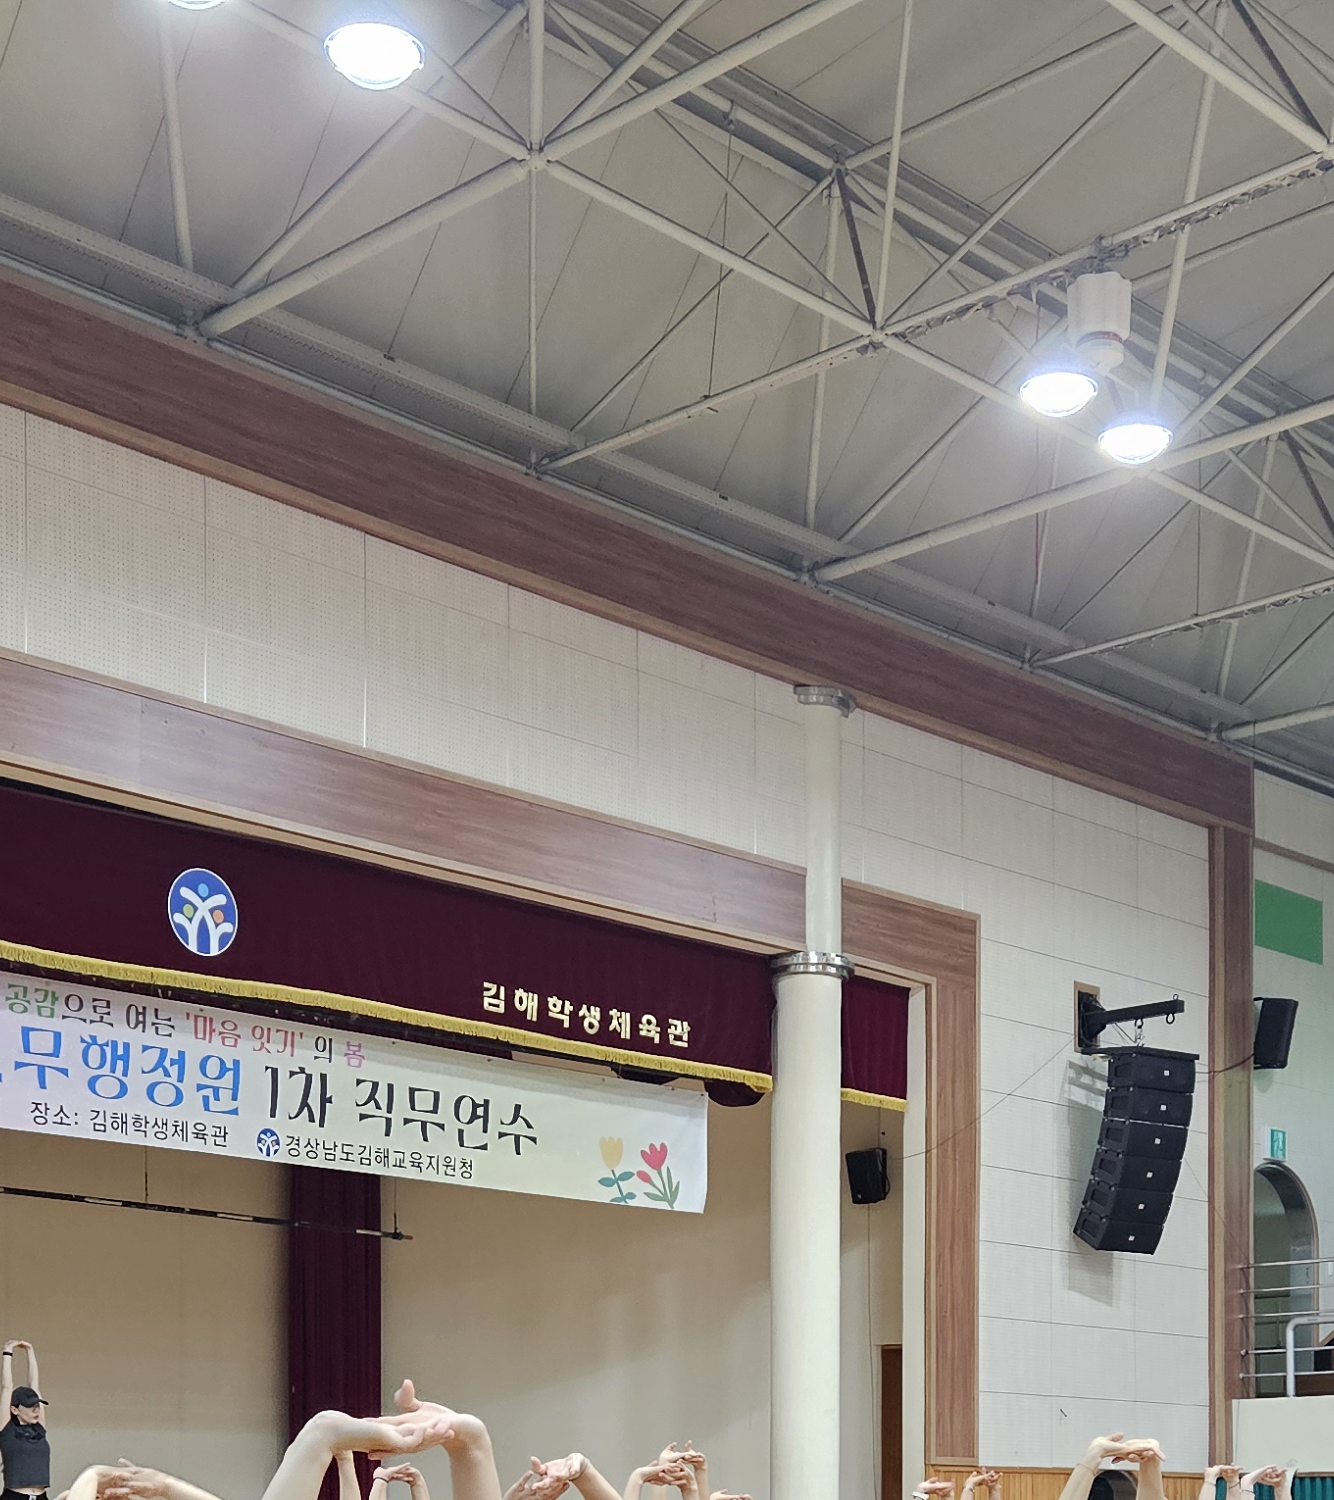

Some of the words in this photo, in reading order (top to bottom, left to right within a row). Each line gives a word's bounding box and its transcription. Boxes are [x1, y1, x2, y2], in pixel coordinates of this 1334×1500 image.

[4, 980, 115, 1028] 공감으로
[125, 1002, 176, 1038] 여는
[343, 1040, 366, 1068] 봄
[483, 981, 691, 1048] 김해학생체육관
[30, 1102, 78, 1126] 장소:
[90, 1110, 228, 1147] 김해학생체육관
[265, 1066, 333, 1128] 1차
[355, 1078, 537, 1155] 직무연수
[286, 1135, 472, 1179] 경상남도김해교육지원청
